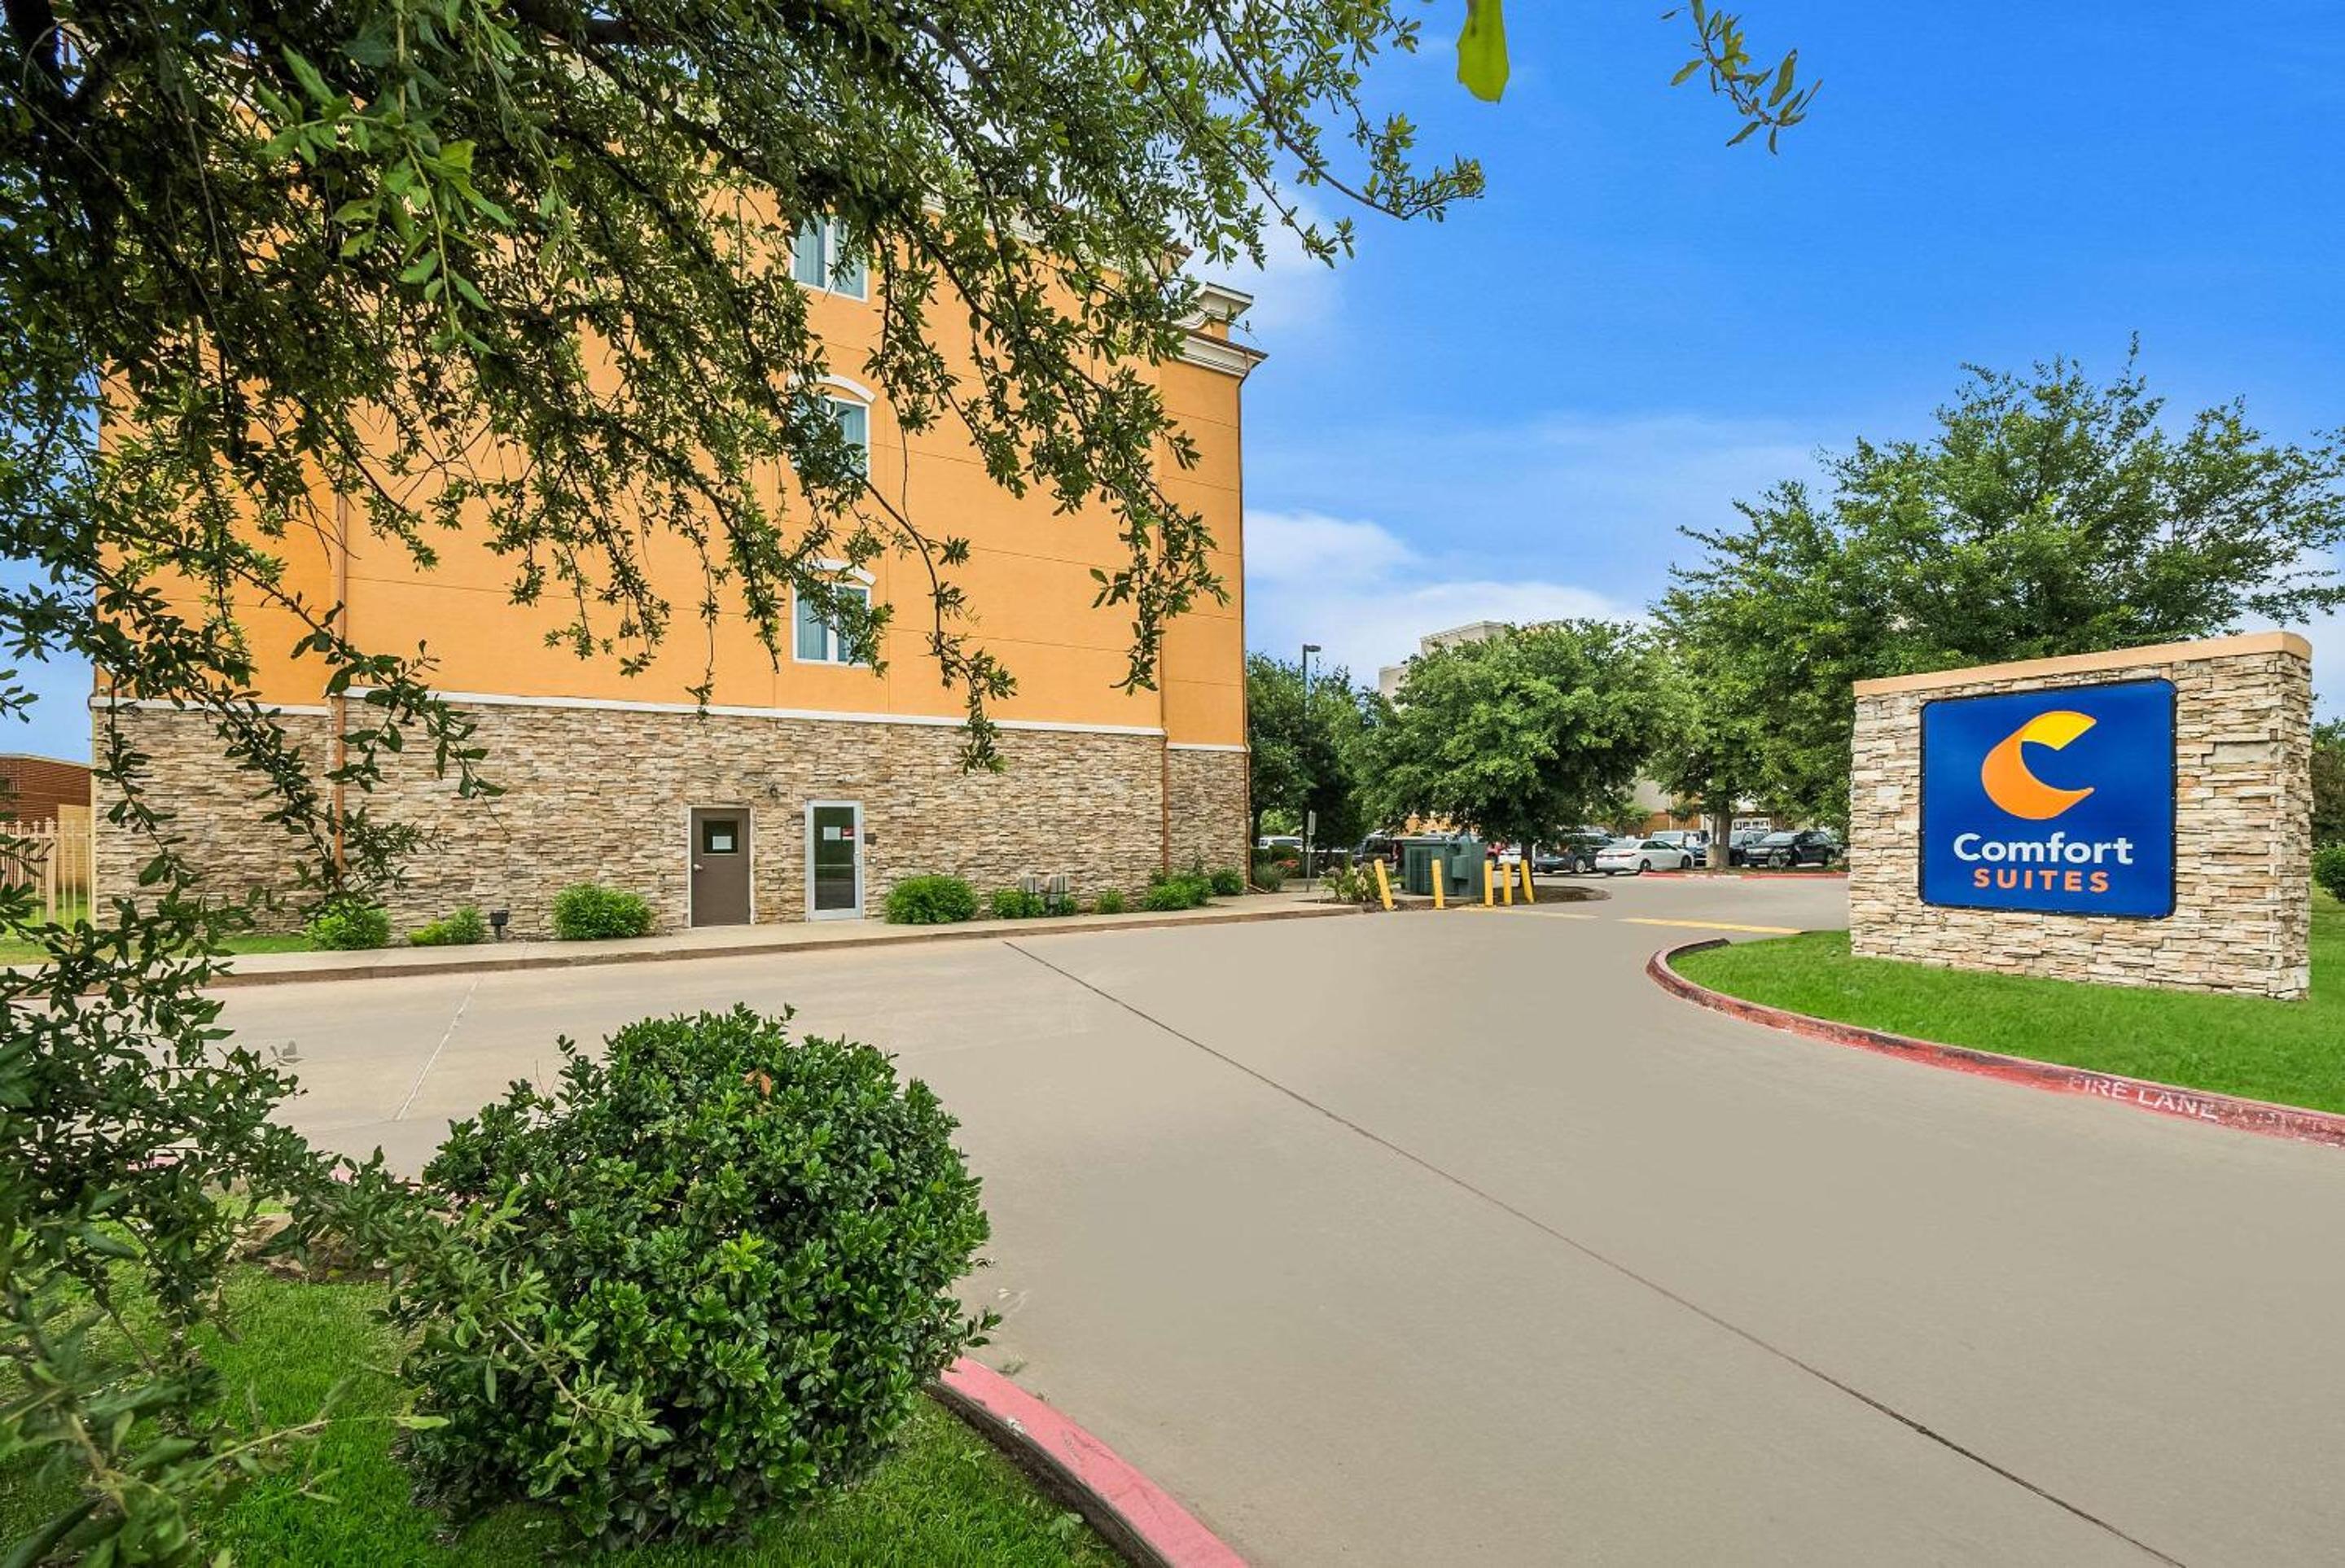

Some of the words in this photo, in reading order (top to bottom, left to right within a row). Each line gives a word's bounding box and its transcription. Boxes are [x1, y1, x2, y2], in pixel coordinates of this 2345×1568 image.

[1953, 831, 2133, 865] Comfort
[1973, 868, 2110, 893] SUITES
[2067, 1075, 2129, 1100] FIRE
[2137, 1088, 2219, 1121] LANE
